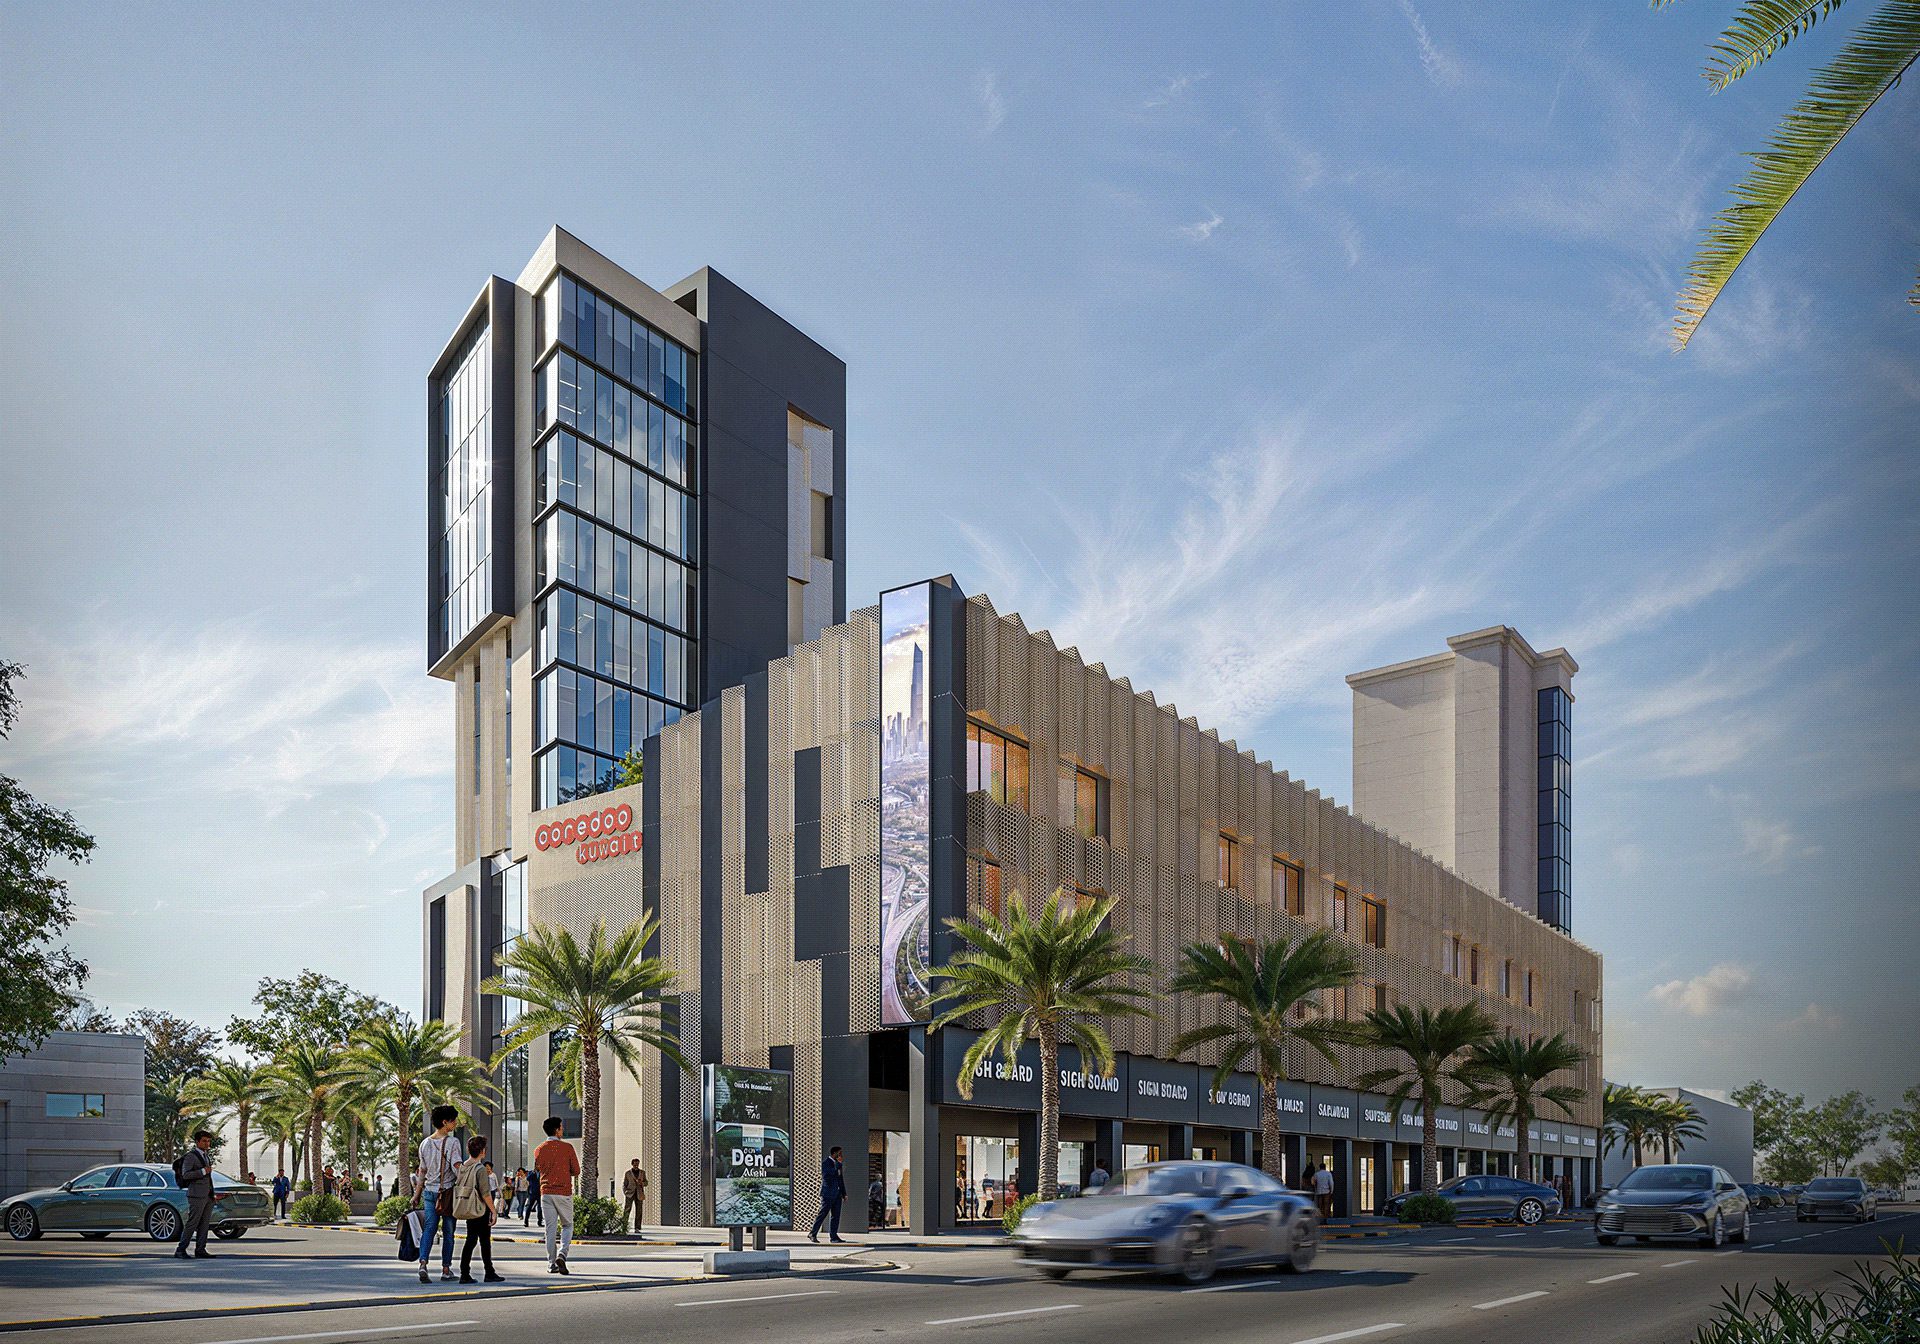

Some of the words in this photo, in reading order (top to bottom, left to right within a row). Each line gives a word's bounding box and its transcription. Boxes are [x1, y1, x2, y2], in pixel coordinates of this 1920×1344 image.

[536, 806, 631, 849] ooredoo
[577, 832, 641, 863] kuwait
[732, 1149, 774, 1167] Dend
